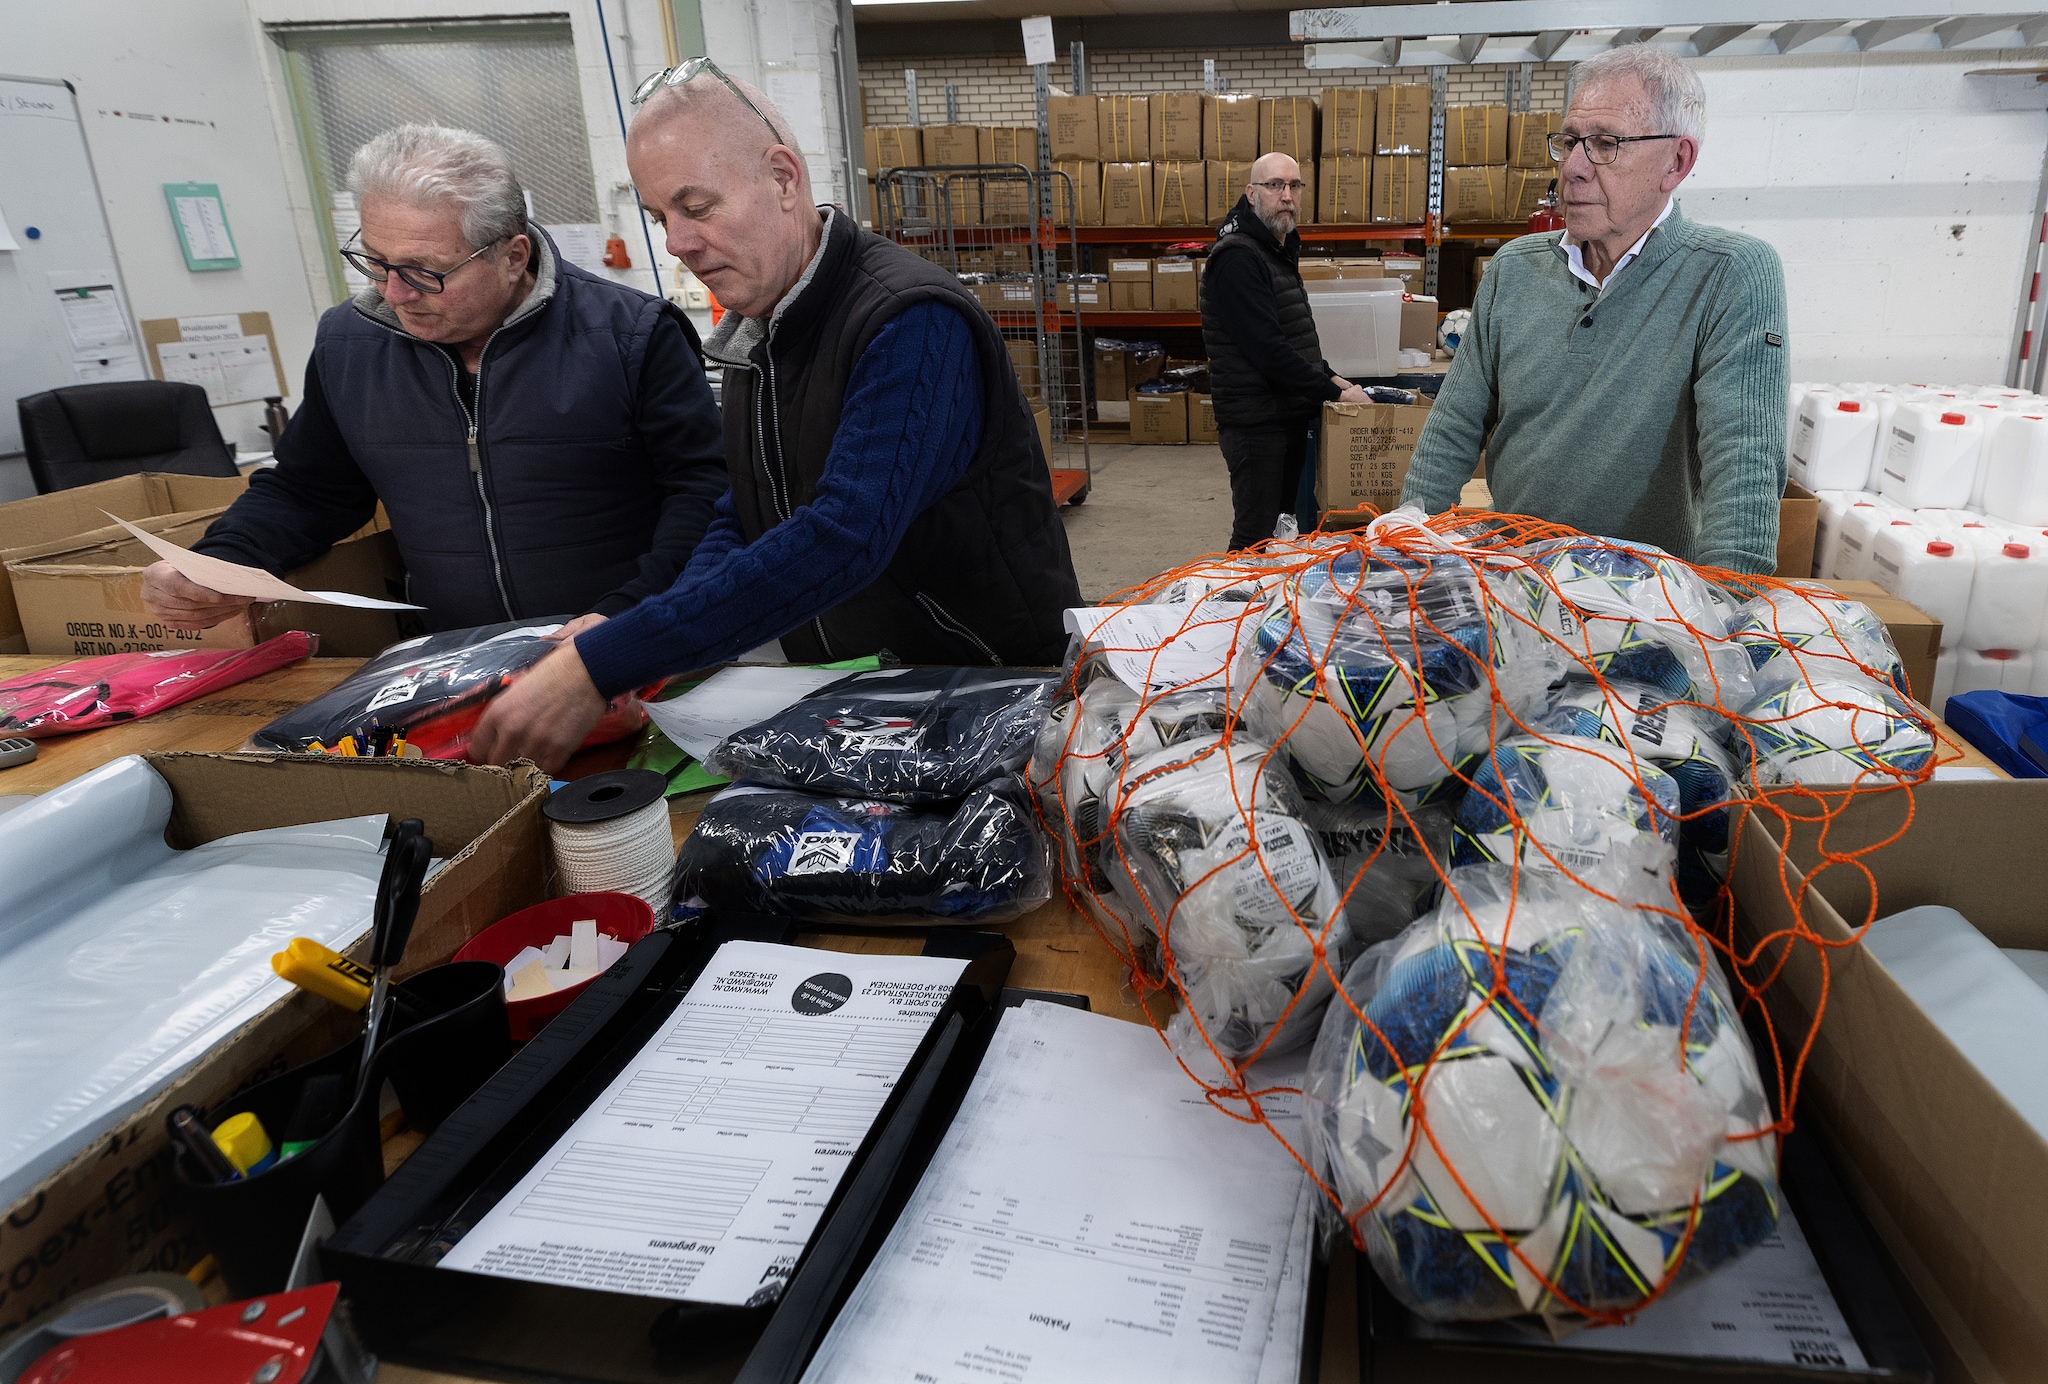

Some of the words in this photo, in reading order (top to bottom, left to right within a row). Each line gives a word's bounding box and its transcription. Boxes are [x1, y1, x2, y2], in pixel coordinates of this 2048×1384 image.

[1350, 427, 1369, 435] ORDER
[1381, 462, 1396, 470] SETS
[1381, 471, 1393, 479] KGS
[66, 622, 105, 638] ORDER
[74, 641, 94, 656] ART
[729, 970, 778, 980] 0314-325624
[716, 977, 774, 988] KWD@KWD.NL
[803, 981, 823, 994] gratis
[870, 980, 924, 991] DOETINCHEM
[938, 984, 954, 992] 008
[712, 984, 769, 996] WWW.KWD.NL
[861, 988, 871, 996] 23
[872, 988, 950, 1000] OUTMOLENSTRAAT
[828, 990, 848, 1003] winkel
[888, 997, 902, 1006] B.V.
[817, 996, 834, 1010] ruilen
[904, 998, 930, 1007] SPORT
[647, 1240, 697, 1252] gegevens
[697, 1245, 714, 1256] Uw
[1029, 1313, 1072, 1332] Pakbon
[1790, 1338, 1840, 1352] SPORT
